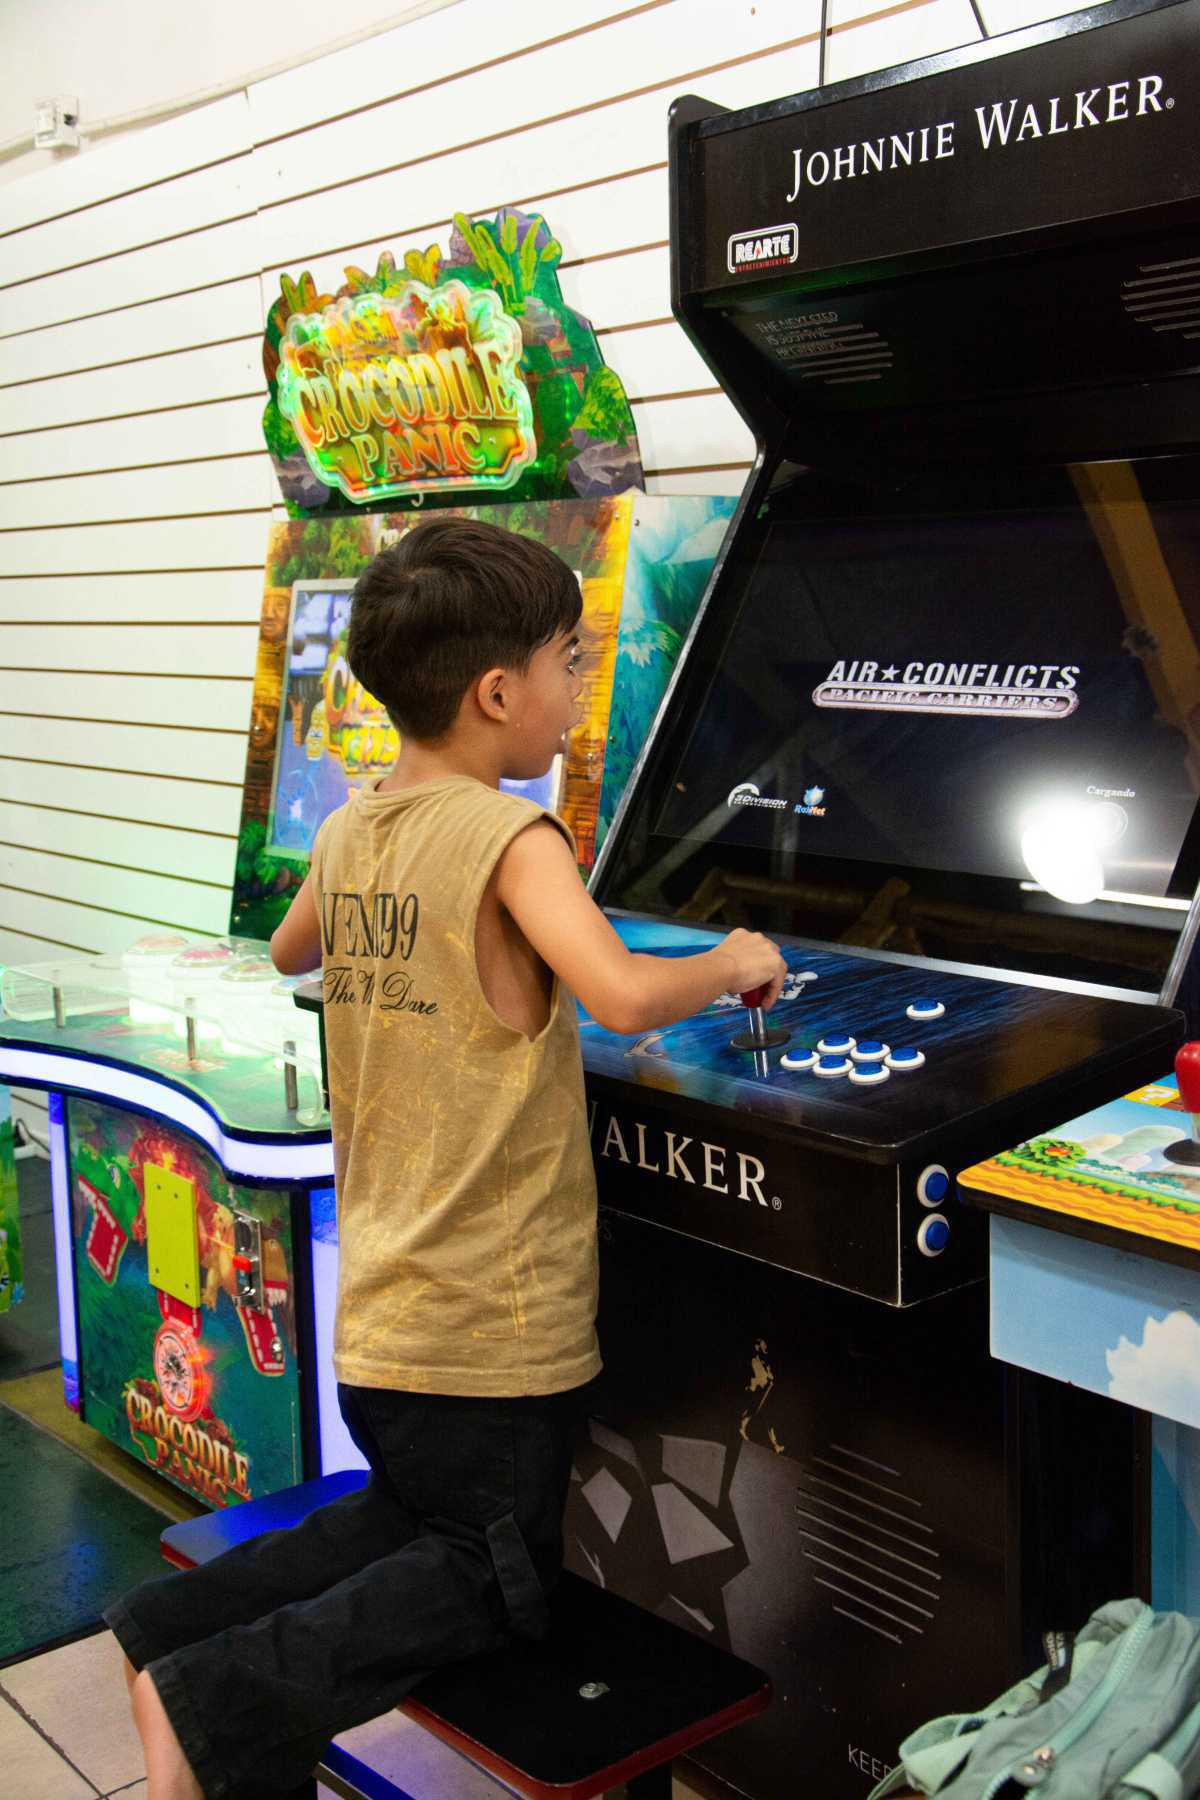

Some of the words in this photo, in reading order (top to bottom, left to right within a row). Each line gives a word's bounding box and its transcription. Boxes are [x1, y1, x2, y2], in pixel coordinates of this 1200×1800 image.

[786, 121, 955, 203] JOHNNIE
[735, 234, 791, 264] REARTE
[295, 341, 520, 449] CROCODILE
[350, 422, 487, 482] PANIC
[826, 660, 879, 682] AIR
[902, 661, 1081, 690] CONFLICTS
[829, 688, 920, 703] PACIFIC
[928, 691, 1059, 709] CARRIERS
[1086, 785, 1136, 801] Cargando
[322, 966, 357, 1005] The
[379, 971, 439, 1015] Dare
[126, 1388, 251, 1498] CROCODILE
[154, 1436, 228, 1503] PANIC
